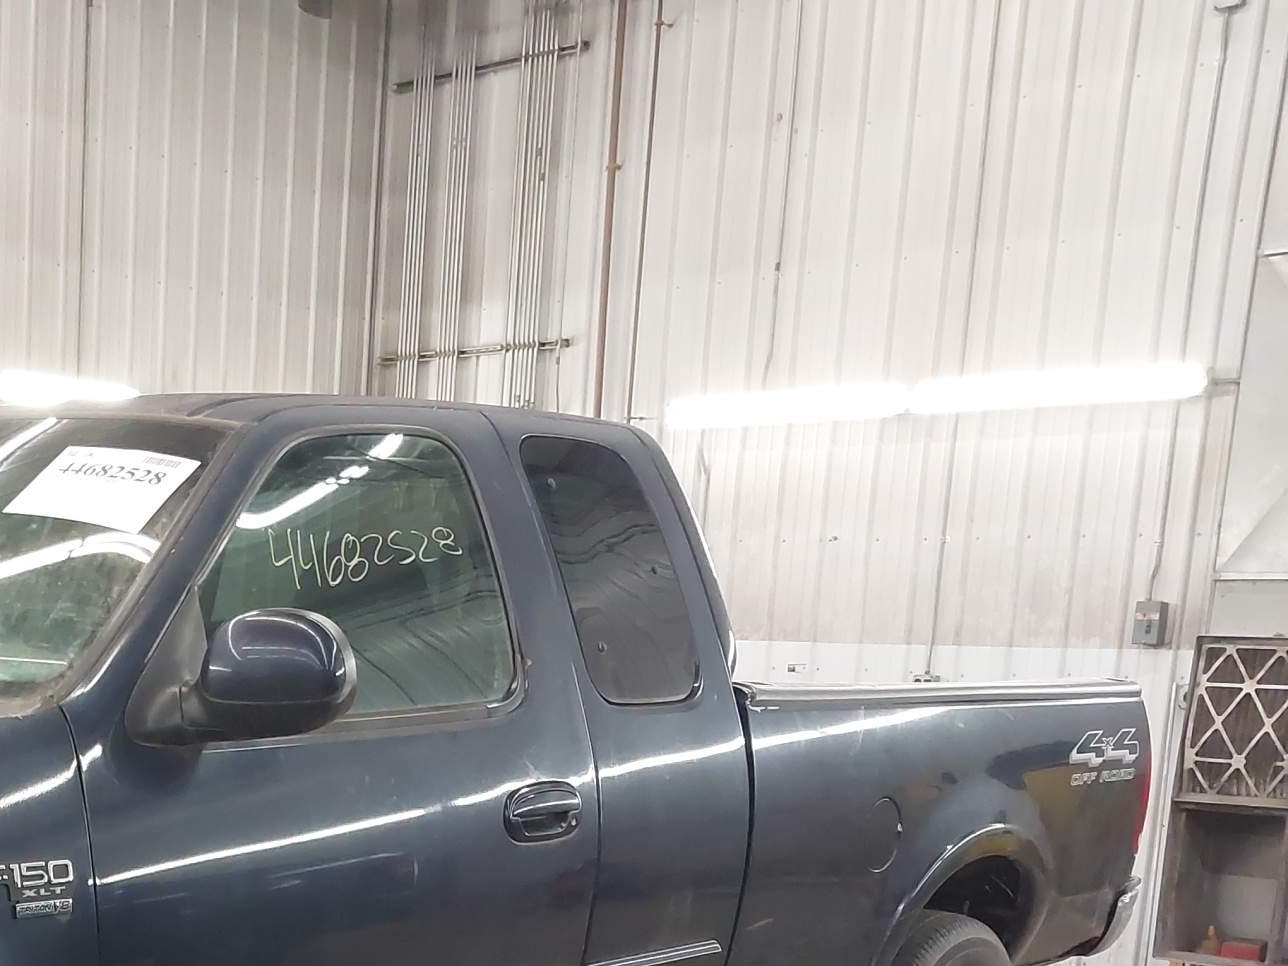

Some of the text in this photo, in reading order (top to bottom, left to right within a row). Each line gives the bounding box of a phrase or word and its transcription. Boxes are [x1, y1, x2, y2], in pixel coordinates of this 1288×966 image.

[58, 461, 167, 485] 44682528
[267, 526, 463, 590] 44682528
[22, 886, 66, 898] XLT
